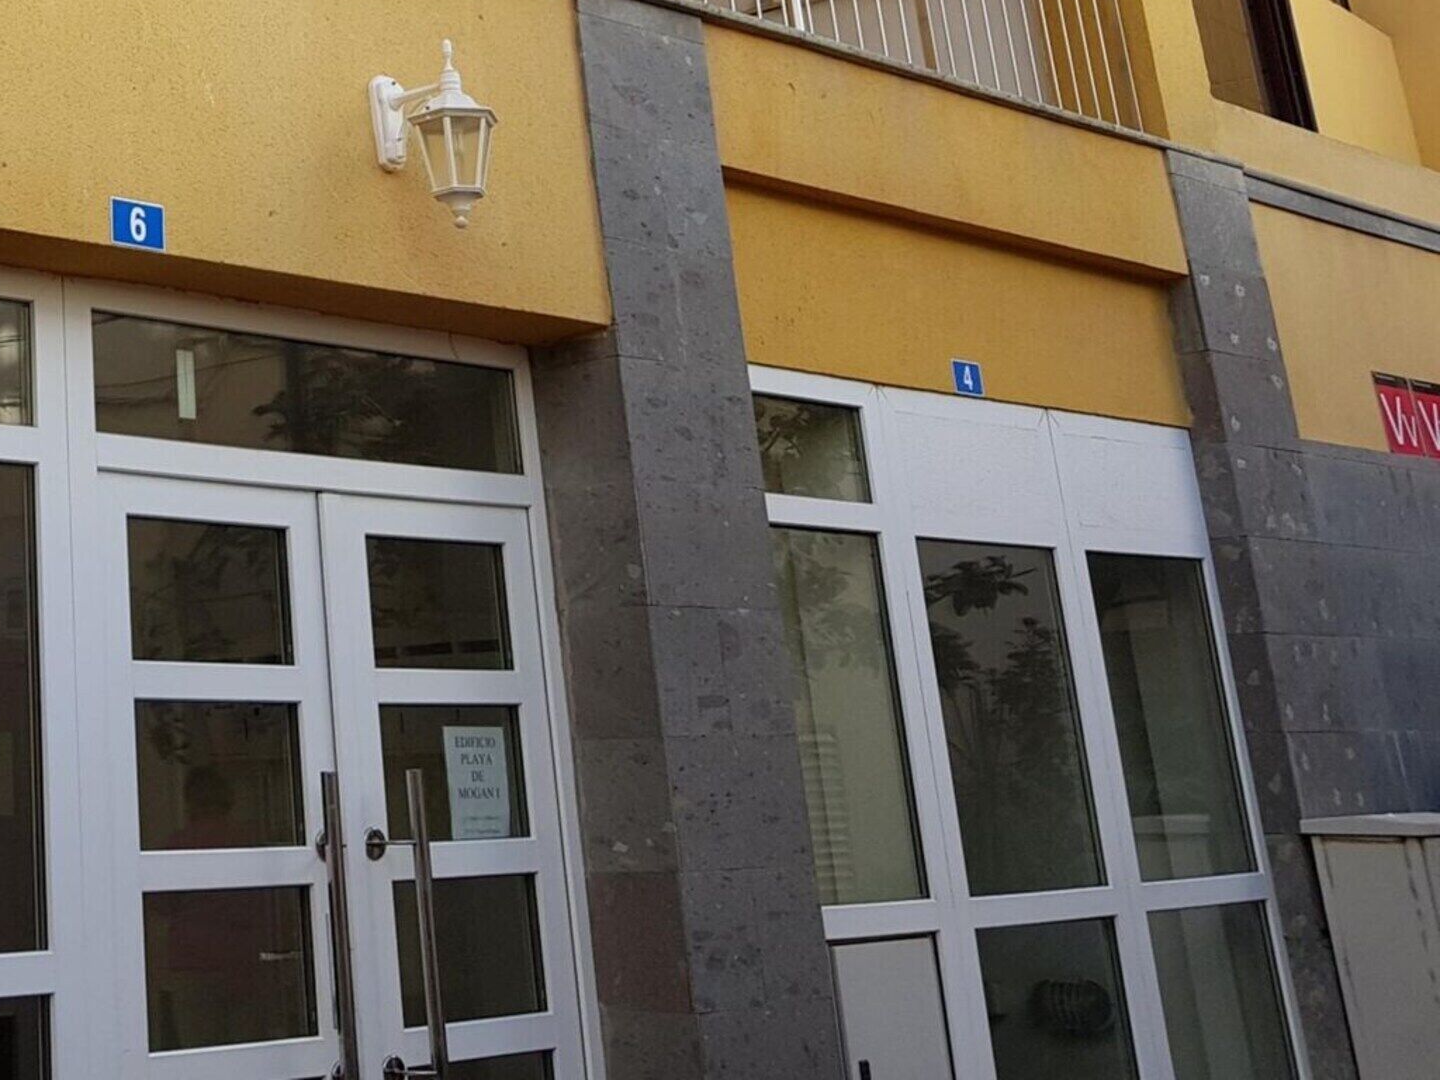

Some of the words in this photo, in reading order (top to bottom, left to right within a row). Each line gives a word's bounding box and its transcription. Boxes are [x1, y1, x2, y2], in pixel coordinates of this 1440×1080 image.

[130, 206, 147, 242] 6
[963, 365, 973, 391] 4
[454, 735, 496, 749] EDIFICIO
[461, 753, 493, 766] PLAYA
[471, 770, 484, 782] DE
